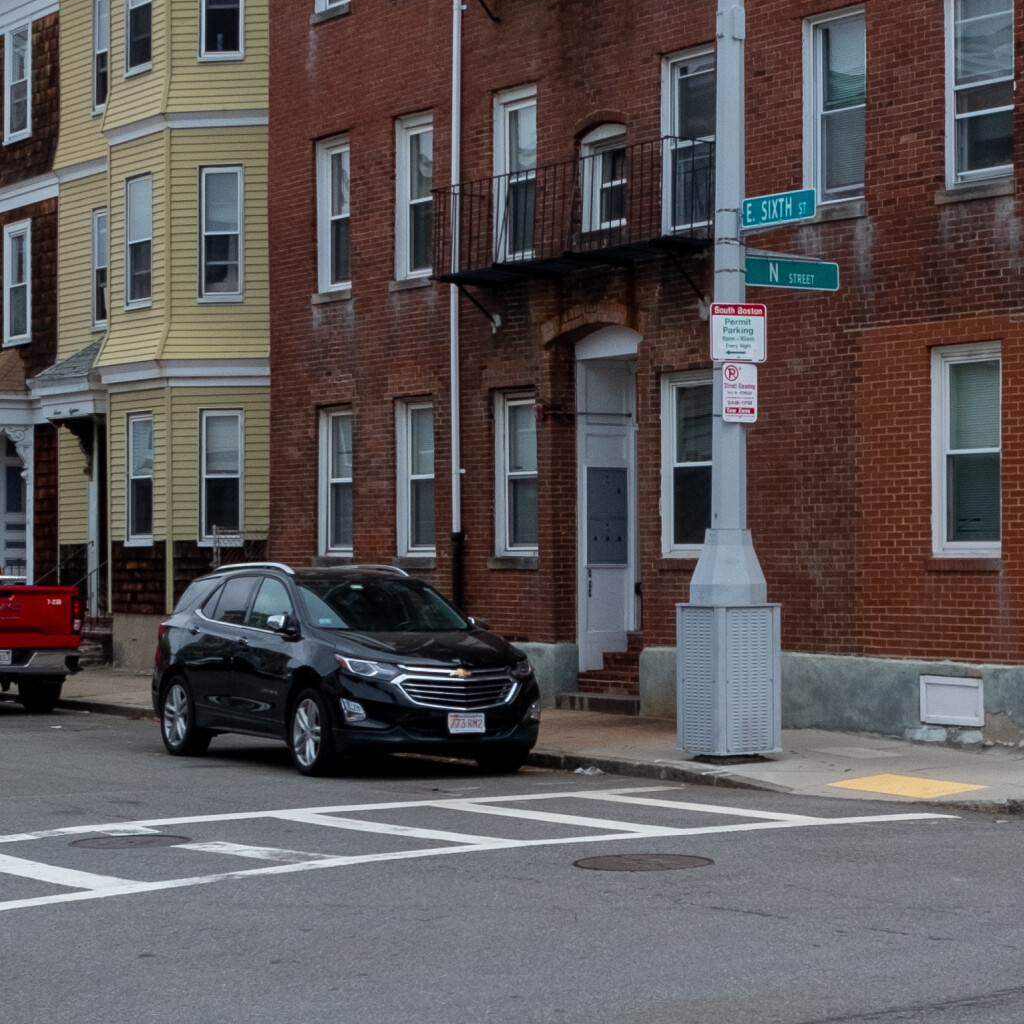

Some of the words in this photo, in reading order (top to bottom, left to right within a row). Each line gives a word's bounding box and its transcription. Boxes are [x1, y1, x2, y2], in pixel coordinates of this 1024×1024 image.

[761, 196, 792, 221] SIXTH
[798, 201, 807, 215] ST
[769, 262, 779, 282] N
[788, 273, 814, 284] STREET
[714, 305, 735, 314] South
[738, 306, 763, 315] Boston
[724, 318, 751, 326] Permit
[722, 326, 754, 335] Parking
